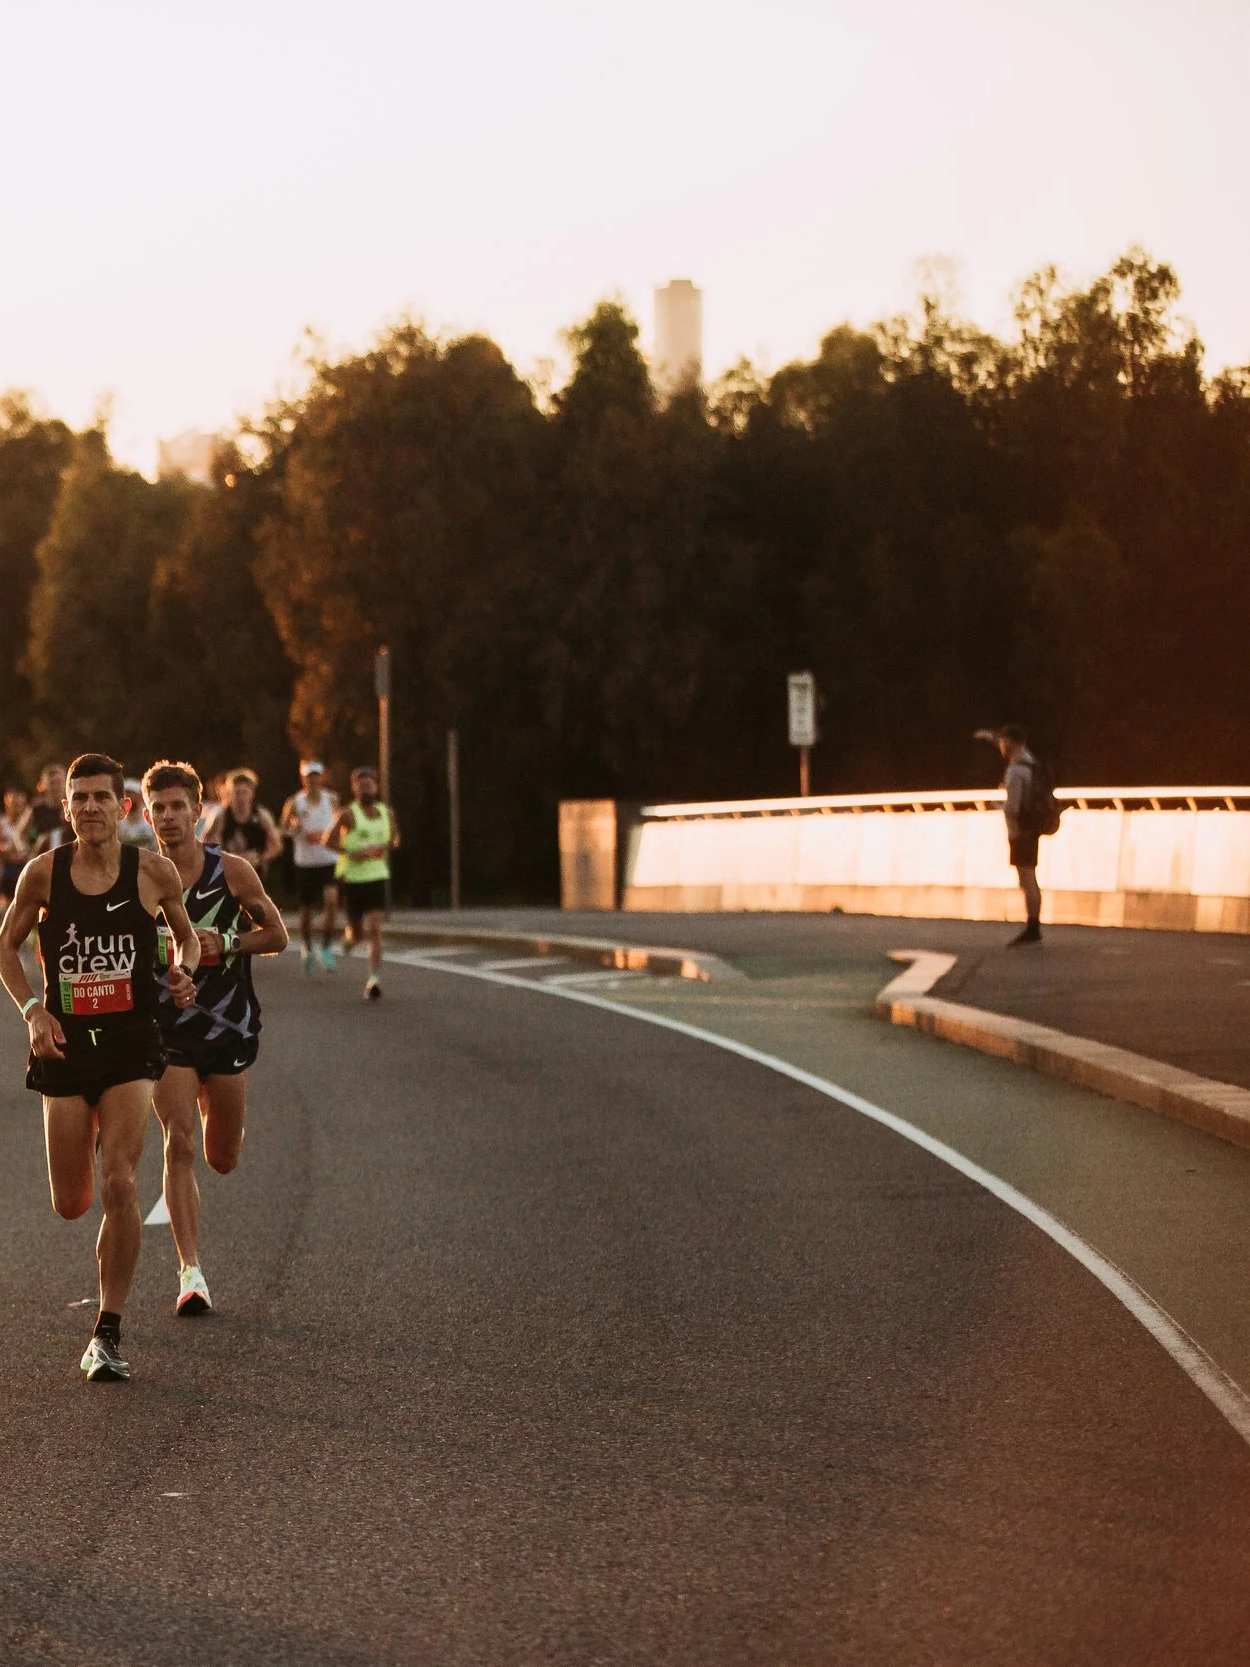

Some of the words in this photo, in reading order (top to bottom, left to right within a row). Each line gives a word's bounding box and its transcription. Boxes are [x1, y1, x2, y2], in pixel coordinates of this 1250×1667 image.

[84, 934, 135, 954] run
[59, 951, 136, 974] crew
[73, 987, 84, 998] DO
[86, 984, 115, 998] CANTO
[92, 998, 98, 1009] 2
